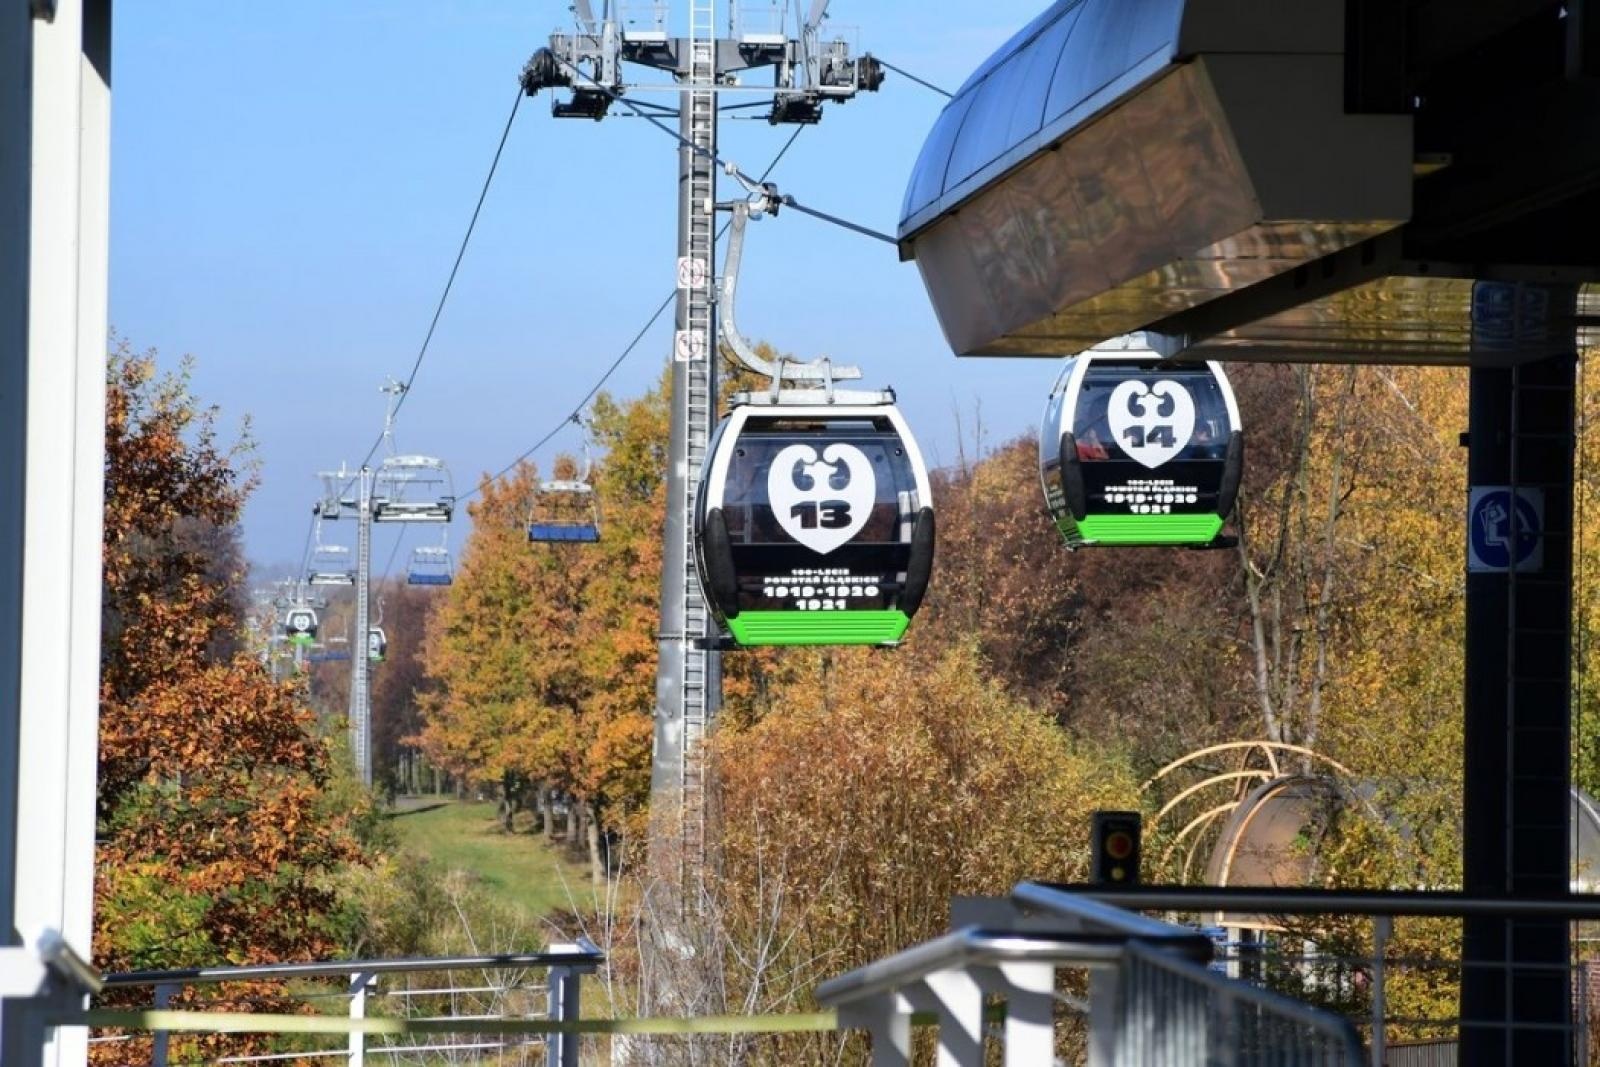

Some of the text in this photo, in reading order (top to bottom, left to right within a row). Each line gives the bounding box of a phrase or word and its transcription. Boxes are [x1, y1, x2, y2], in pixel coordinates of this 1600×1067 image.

[1123, 425, 1177, 448] 14
[790, 499, 853, 529] 13
[796, 599, 847, 611] 1921
